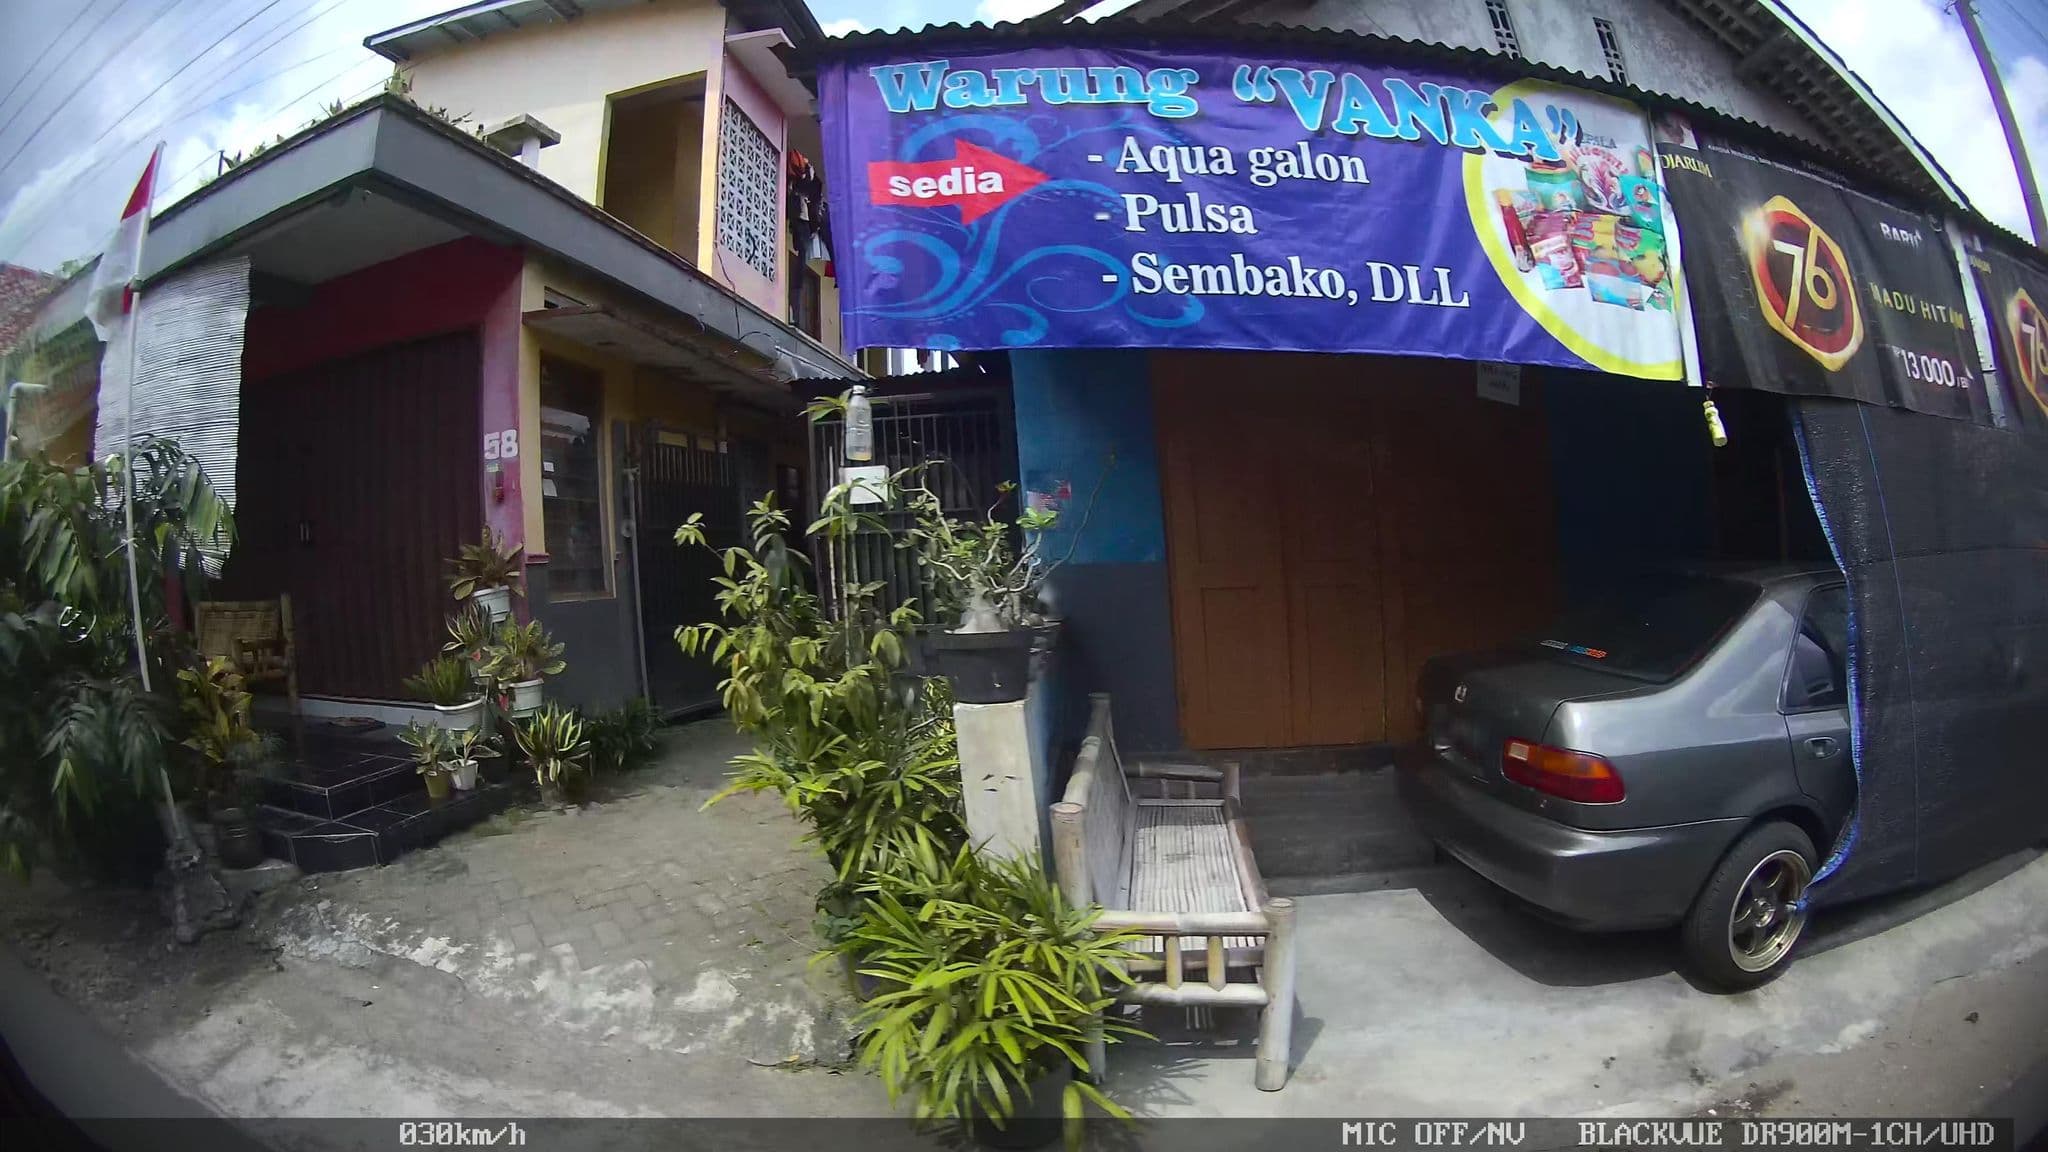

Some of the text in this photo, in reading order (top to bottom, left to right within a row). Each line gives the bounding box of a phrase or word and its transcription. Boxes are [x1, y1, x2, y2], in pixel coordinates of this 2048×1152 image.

[870, 60, 1200, 118] Warung
[888, 166, 1005, 198] sedia
[1115, 136, 1237, 183] Aqua
[1248, 142, 1370, 187] galon
[1121, 192, 1258, 235] Pulsa
[1131, 252, 1358, 306] Sembako,
[1367, 262, 1471, 308] DLL
[1773, 227, 1837, 330] 76
[484, 429, 518, 460] 58
